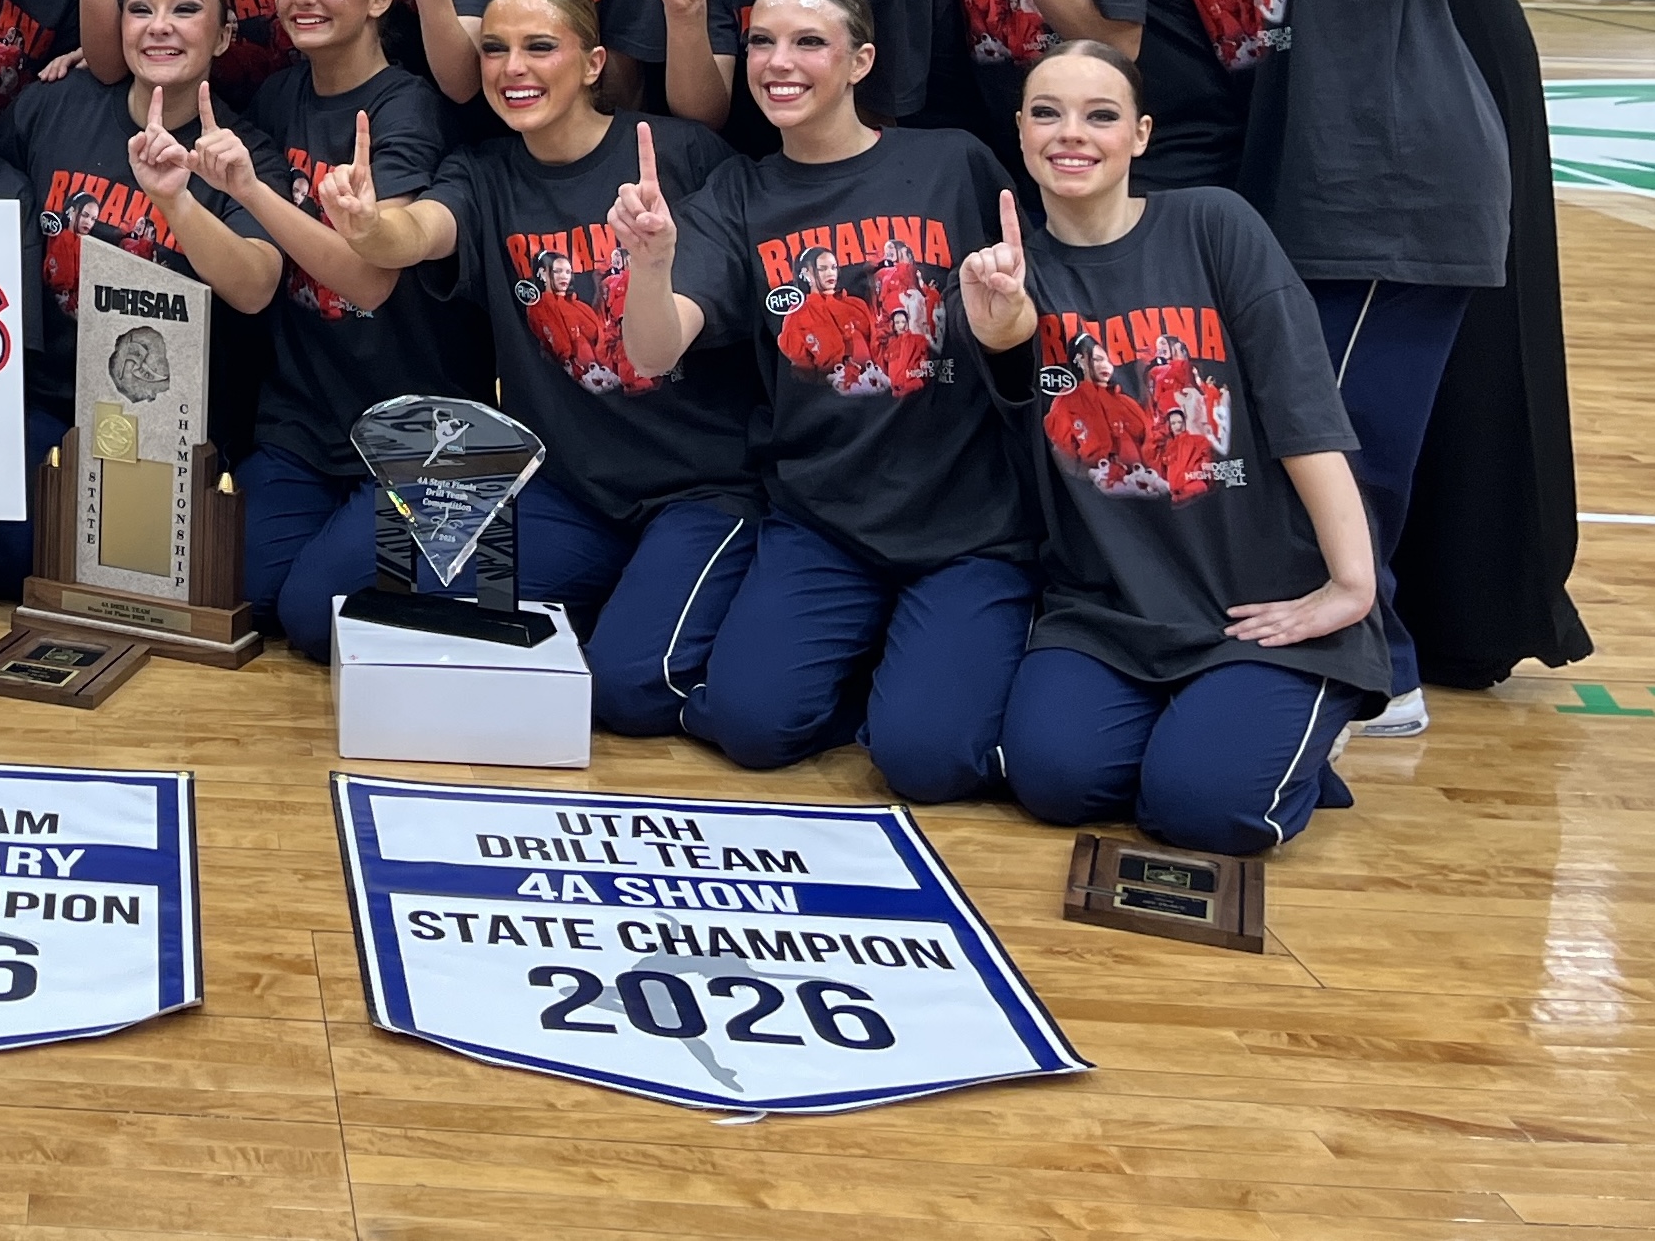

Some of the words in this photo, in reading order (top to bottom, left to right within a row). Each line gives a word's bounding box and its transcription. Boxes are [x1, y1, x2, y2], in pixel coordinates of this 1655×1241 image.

[517, 286, 537, 299] RHS
[770, 294, 800, 308] RHS
[1040, 374, 1072, 388] RHS
[175, 404, 190, 588] CHAMPIONSHIP
[417, 477, 428, 485] 4A
[425, 488, 444, 497] Drill
[86, 472, 97, 545] STATE
[131, 607, 150, 615] TEAM
[555, 812, 704, 842] UTAH
[475, 834, 639, 866] DRILL
[645, 841, 811, 875] TEAM
[517, 872, 601, 904] 4A
[613, 877, 799, 913] SHOW
[409, 910, 611, 952] STATE
[617, 919, 956, 970] CHAMPION
[526, 965, 895, 1051] 2026
